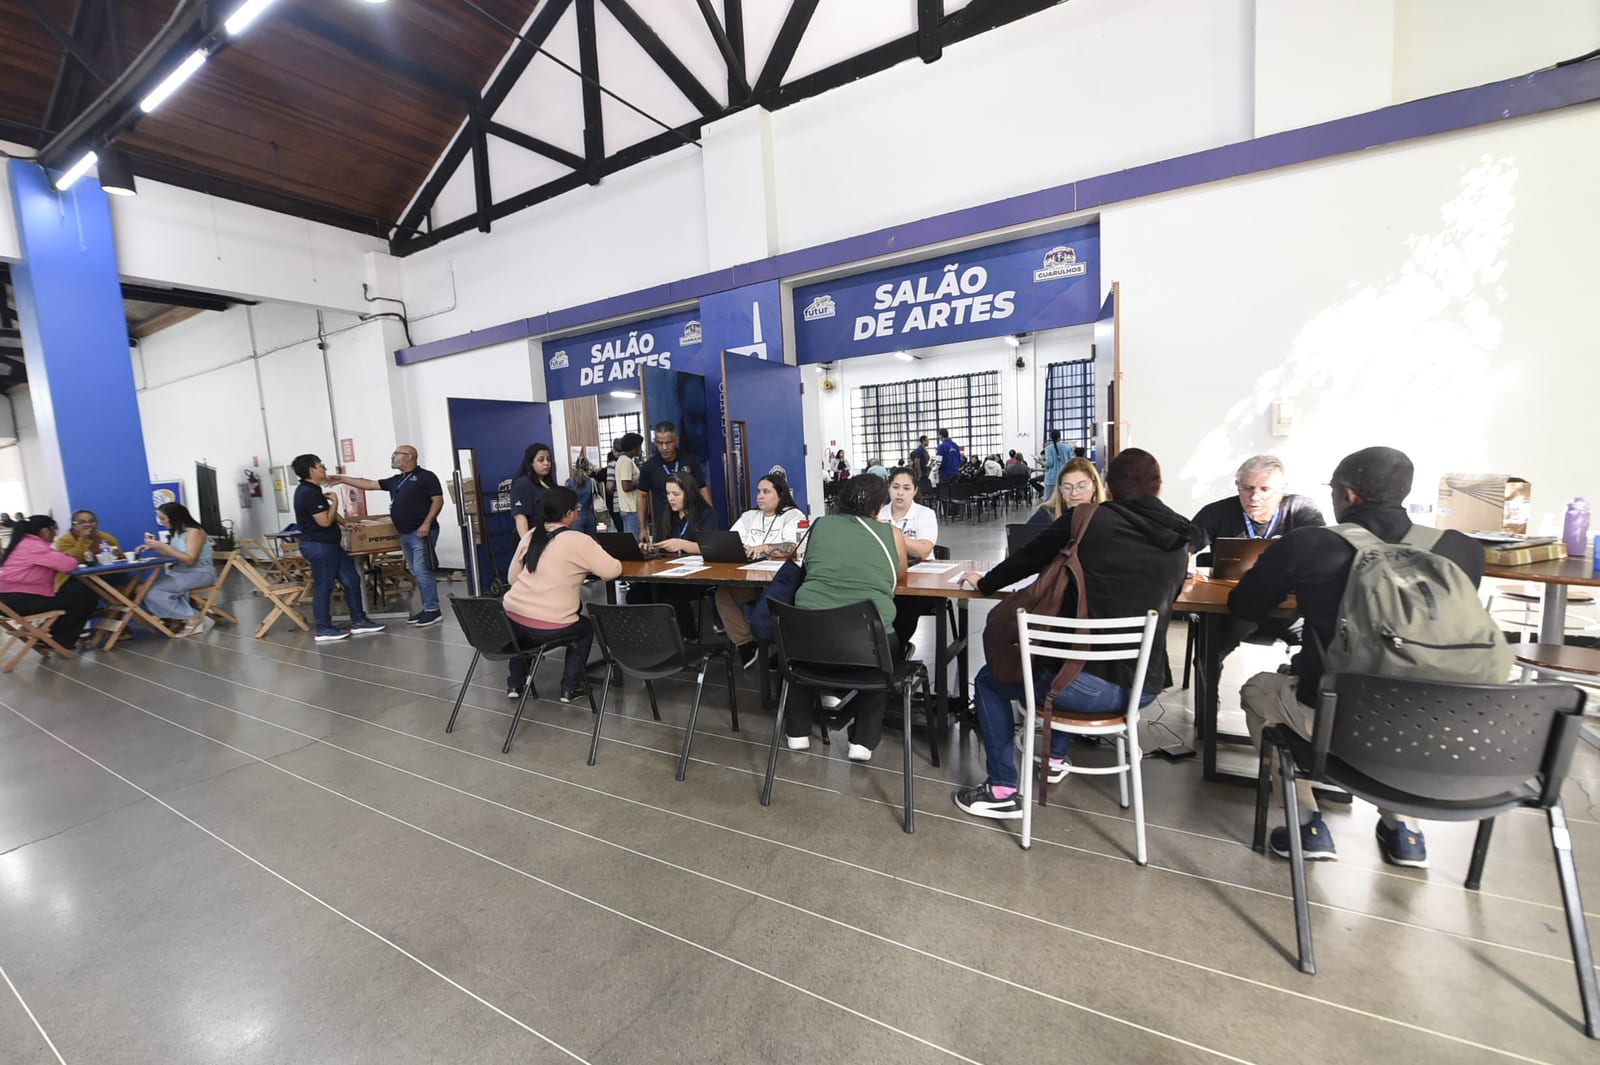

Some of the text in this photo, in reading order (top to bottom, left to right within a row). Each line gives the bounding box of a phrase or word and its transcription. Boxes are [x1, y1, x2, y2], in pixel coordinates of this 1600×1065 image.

[873, 263, 988, 310] SALÃO
[1038, 266, 1082, 279] GUARULHOS
[853, 290, 1016, 341] DE ARTES
[591, 330, 655, 364] SALÃO
[580, 364, 604, 387] DE
[368, 534, 400, 543] PEPSIC
